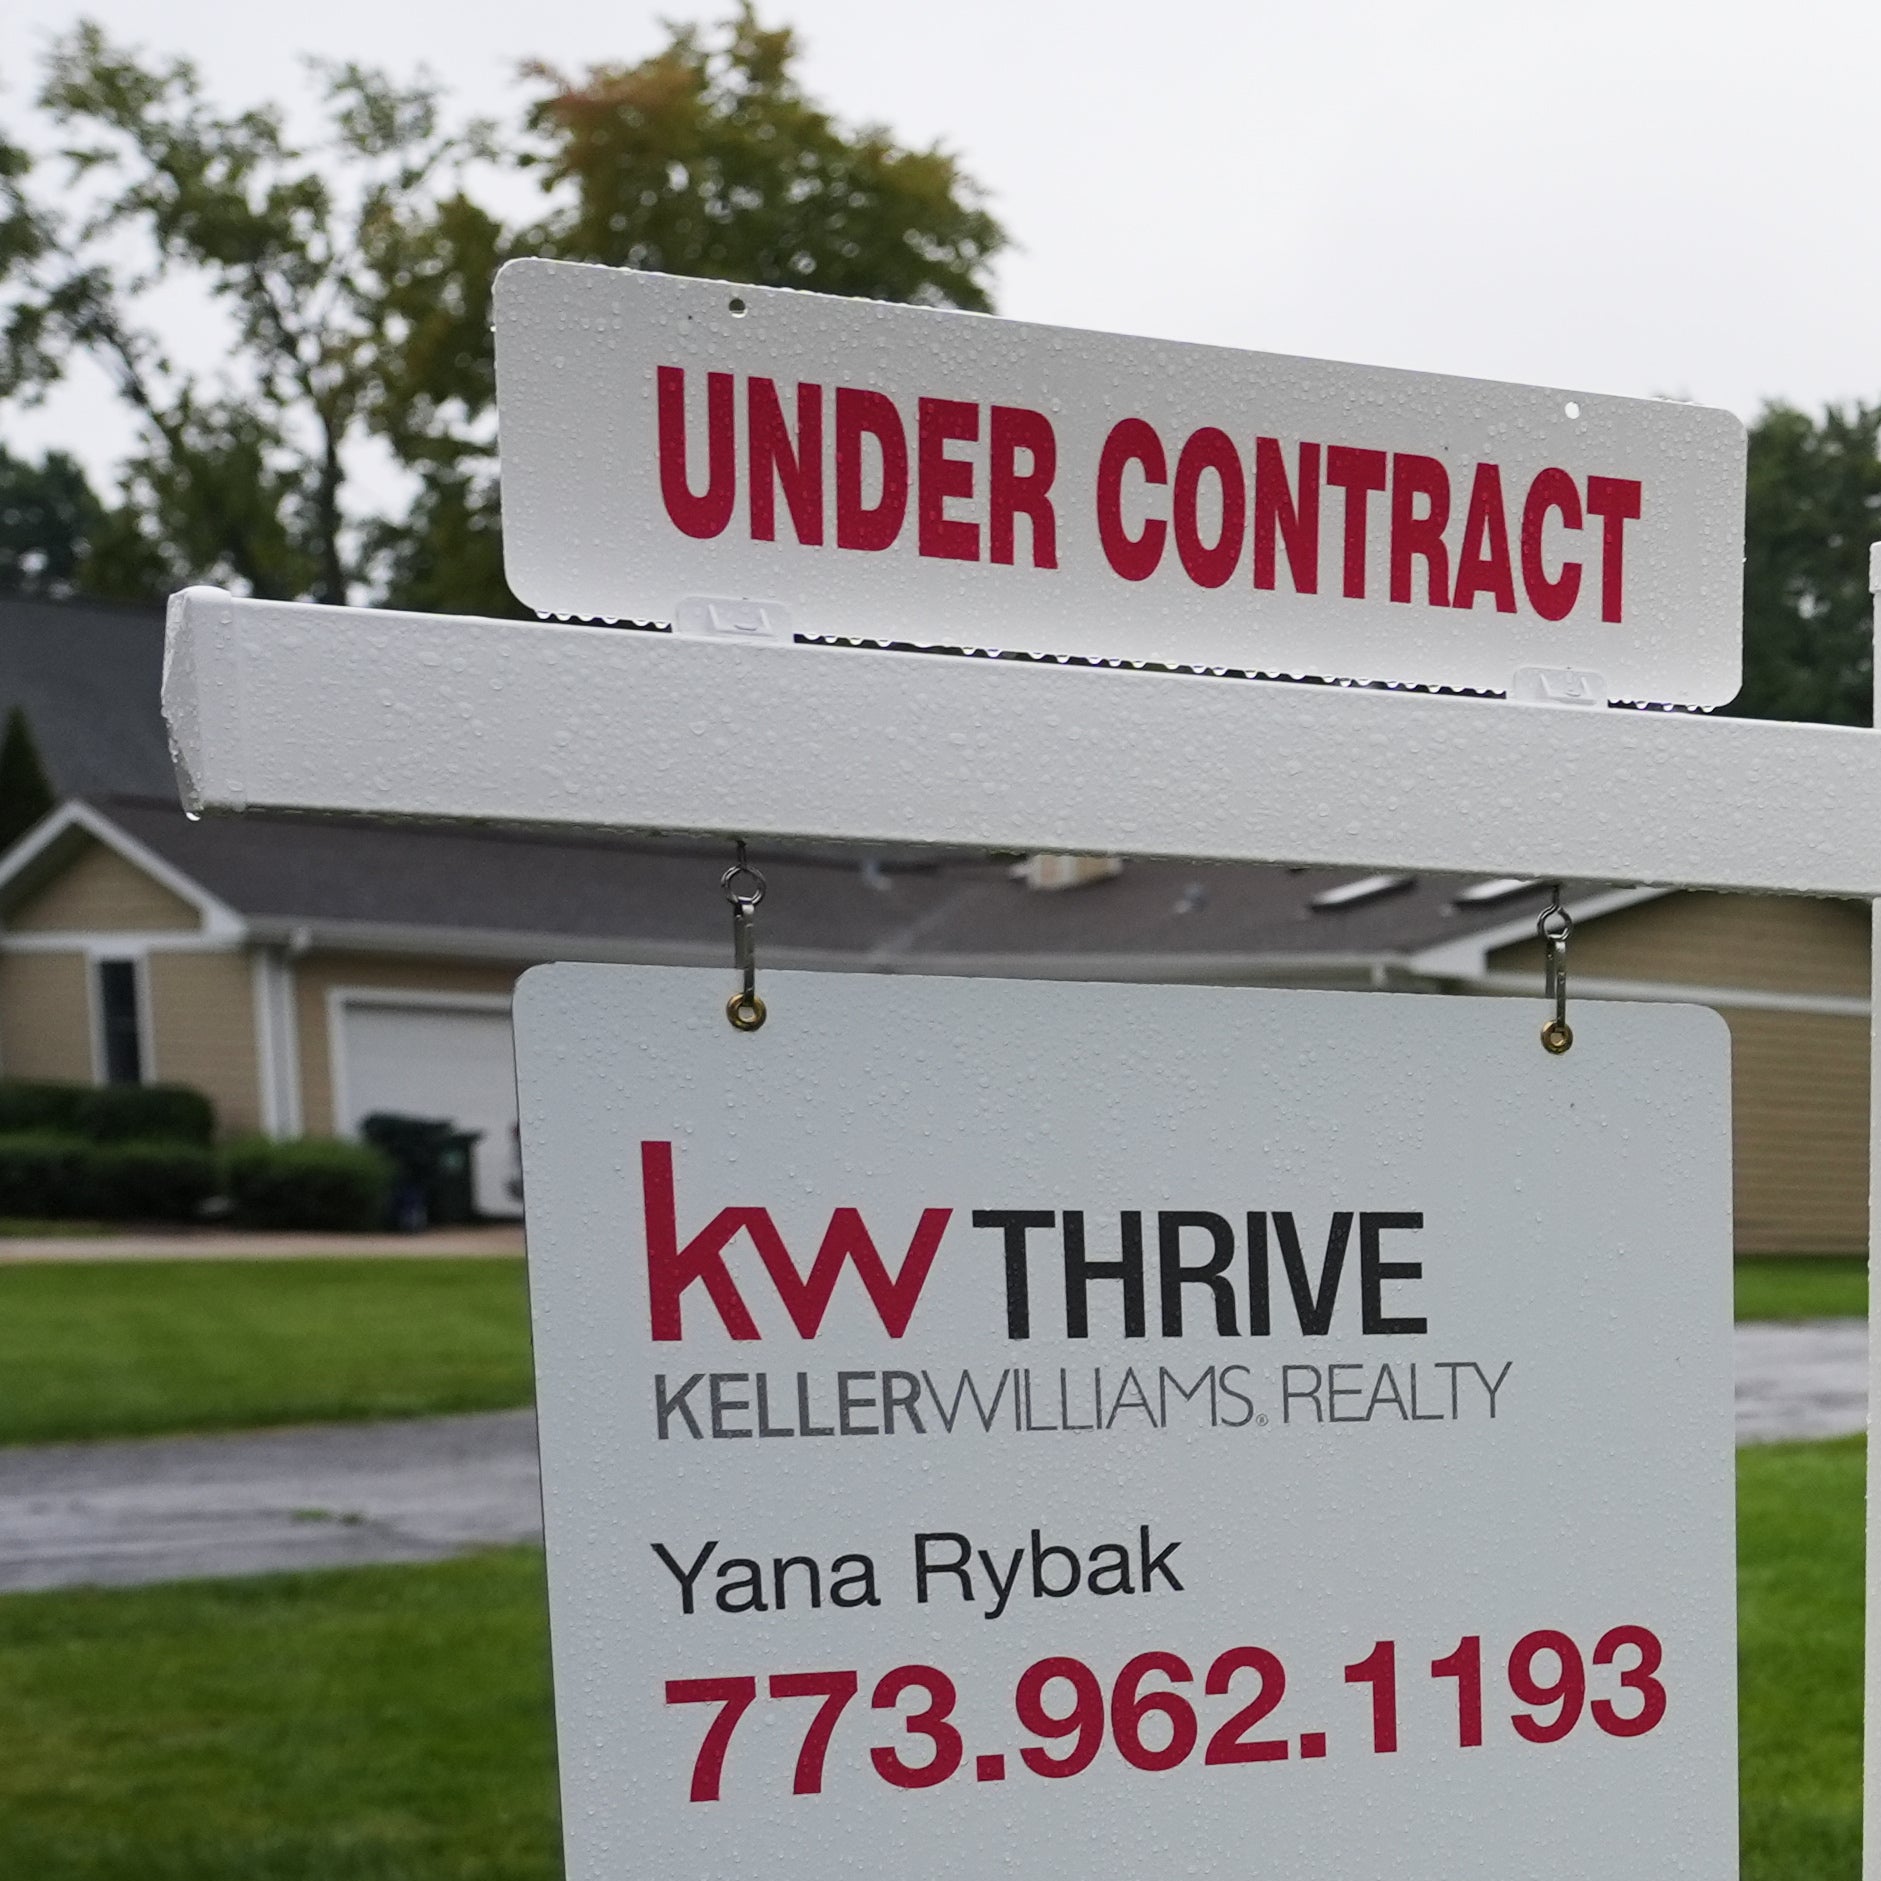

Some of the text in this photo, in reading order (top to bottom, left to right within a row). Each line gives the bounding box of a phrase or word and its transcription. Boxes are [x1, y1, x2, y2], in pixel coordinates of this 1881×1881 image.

[656, 365, 1643, 625] UNDER CONTRACT
[641, 1140, 1428, 1342] kw THRIVE
[1281, 1360, 1514, 1425] REALTY
[650, 1524, 1186, 1621] Yana Rybak
[665, 1624, 1667, 1804] 773.962.1193
